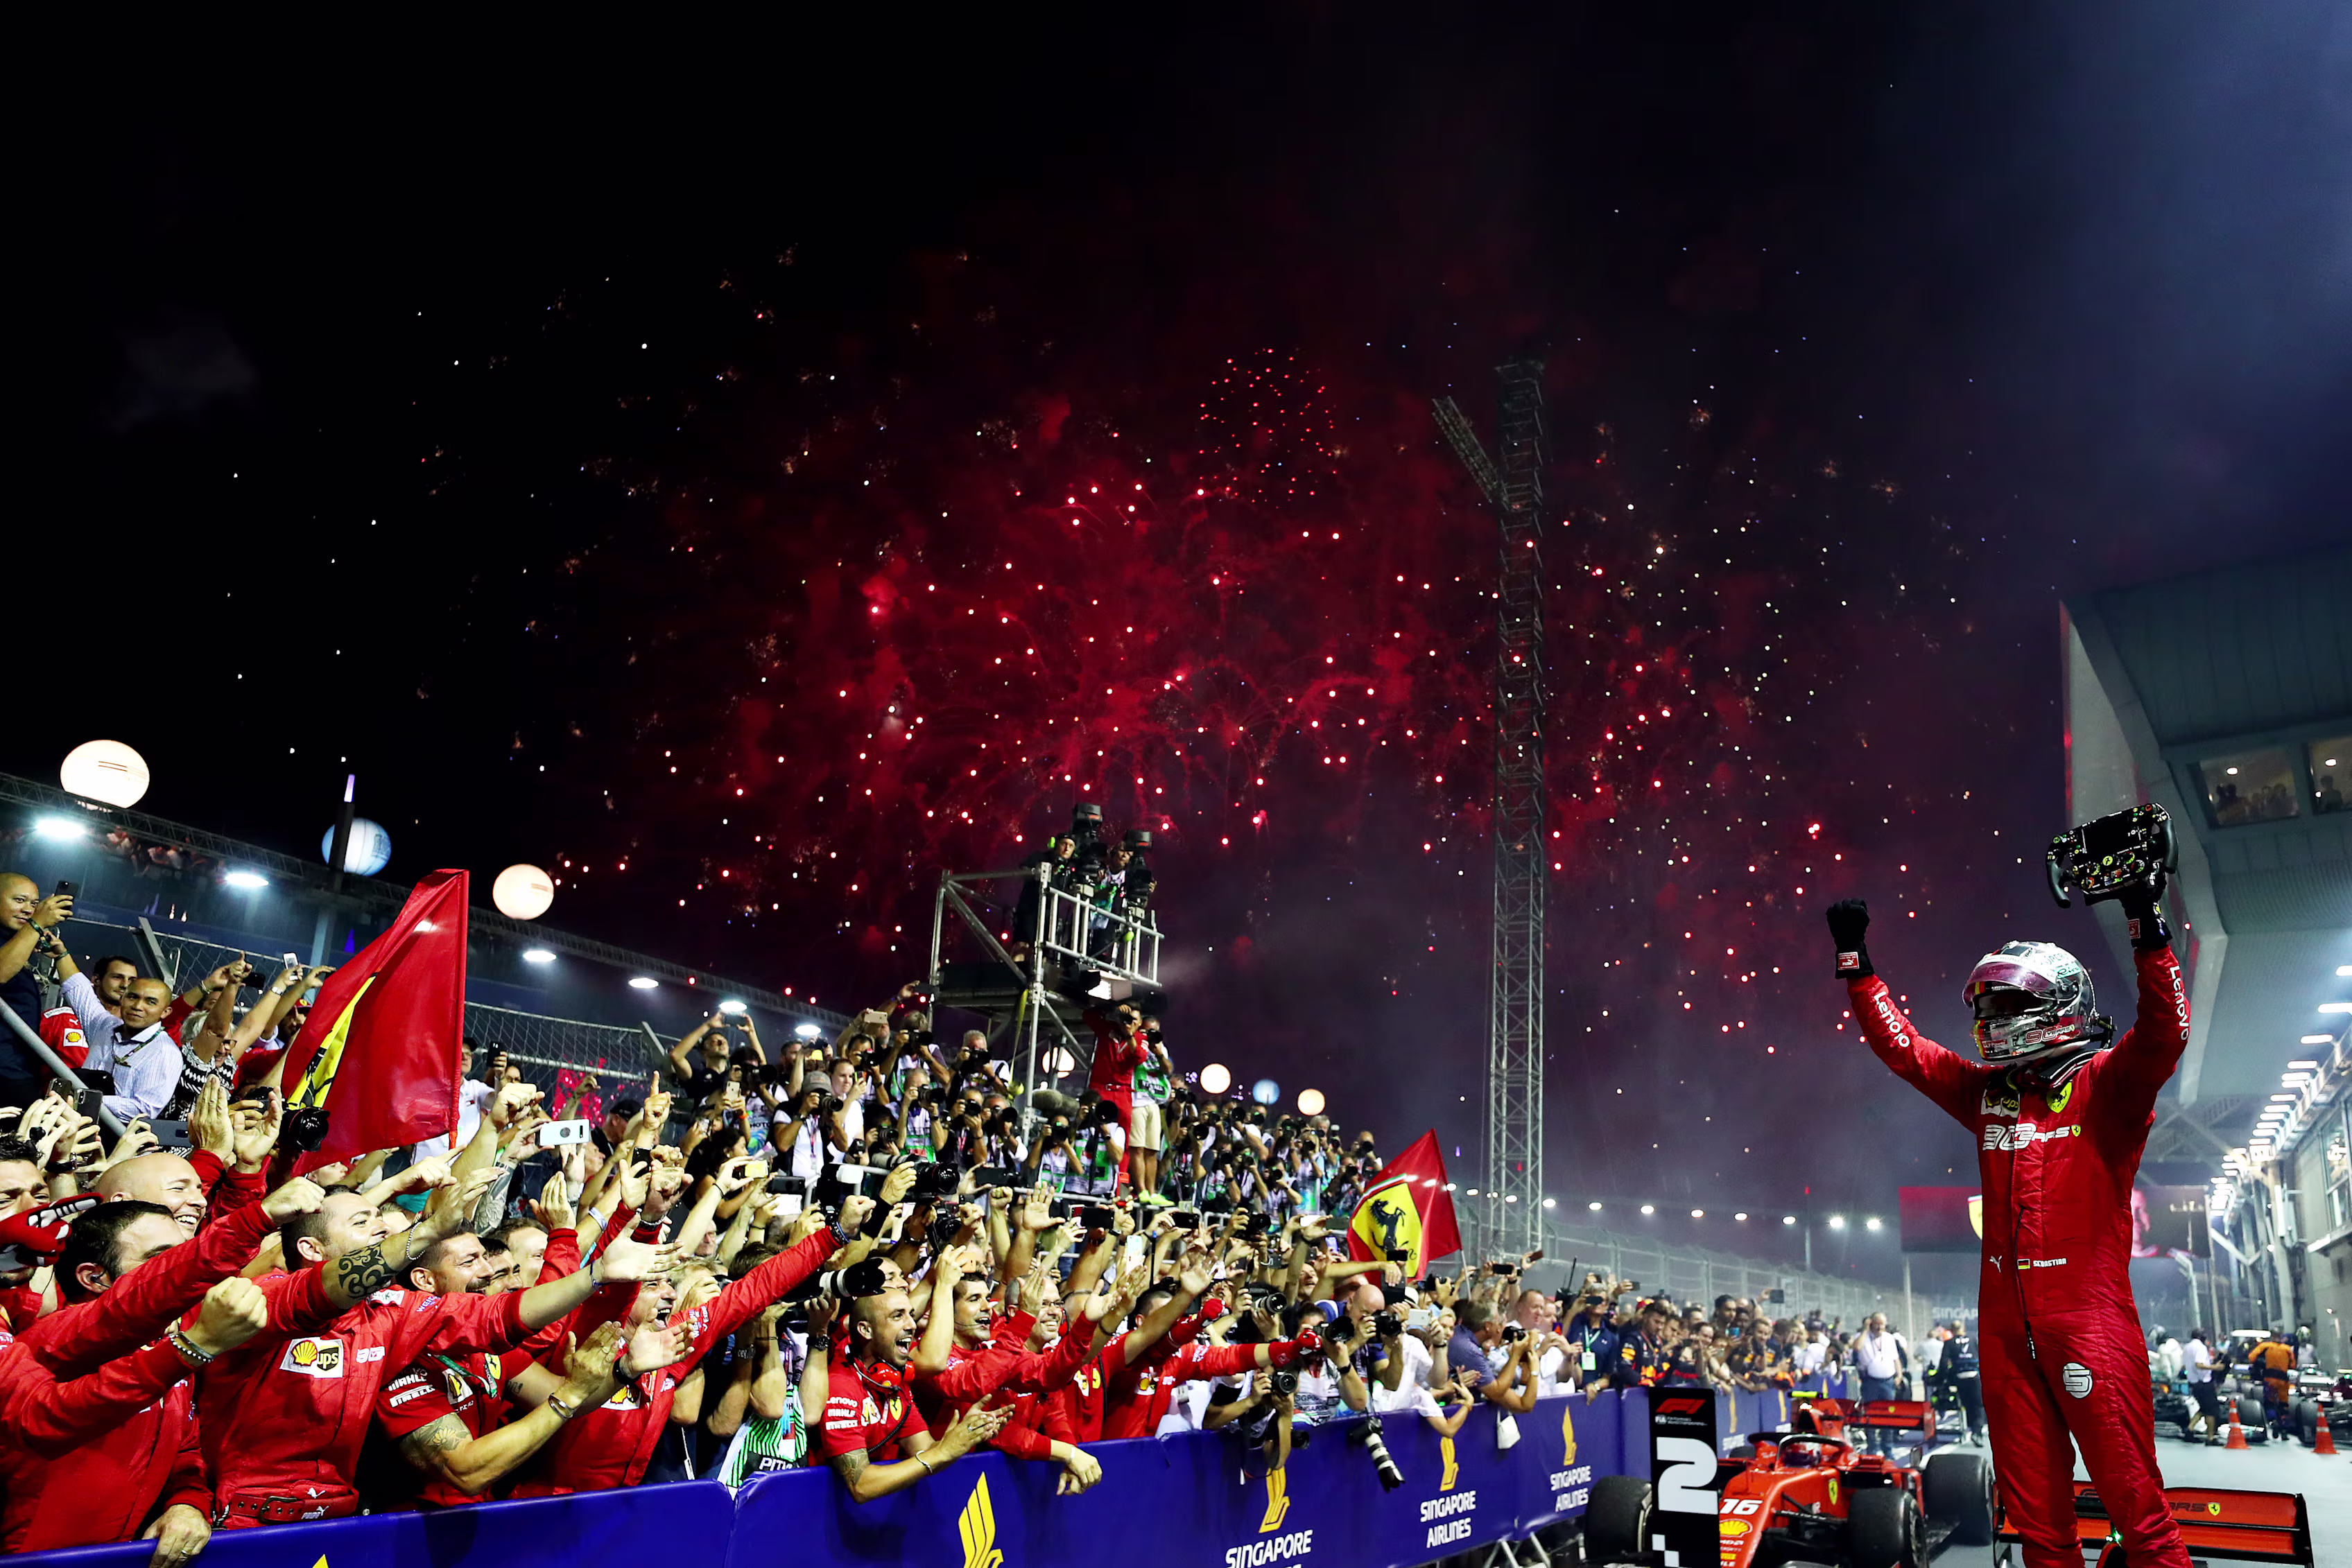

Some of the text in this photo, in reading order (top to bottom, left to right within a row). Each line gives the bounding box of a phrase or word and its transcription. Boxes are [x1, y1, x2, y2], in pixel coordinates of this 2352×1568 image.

[2169, 965, 2190, 1040] Lenovo
[1874, 991, 1910, 1047] Lenovo
[2033, 1258, 2067, 1267] SEBASTIAN
[1932, 1307, 1978, 1320] SINGAP
[317, 1352, 339, 1369] ups
[2064, 1369, 2092, 1393] 5
[1550, 1465, 1591, 1491] SINGAPORE
[1657, 1436, 1718, 1515] 2
[1420, 1490, 1476, 1522] SINGAPORE
[1555, 1488, 1589, 1513] AIRLINES
[1720, 1498, 1763, 1515] 16
[1426, 1517, 1471, 1549] AIRLINES
[1225, 1529, 1313, 1568] SINGAPORE
